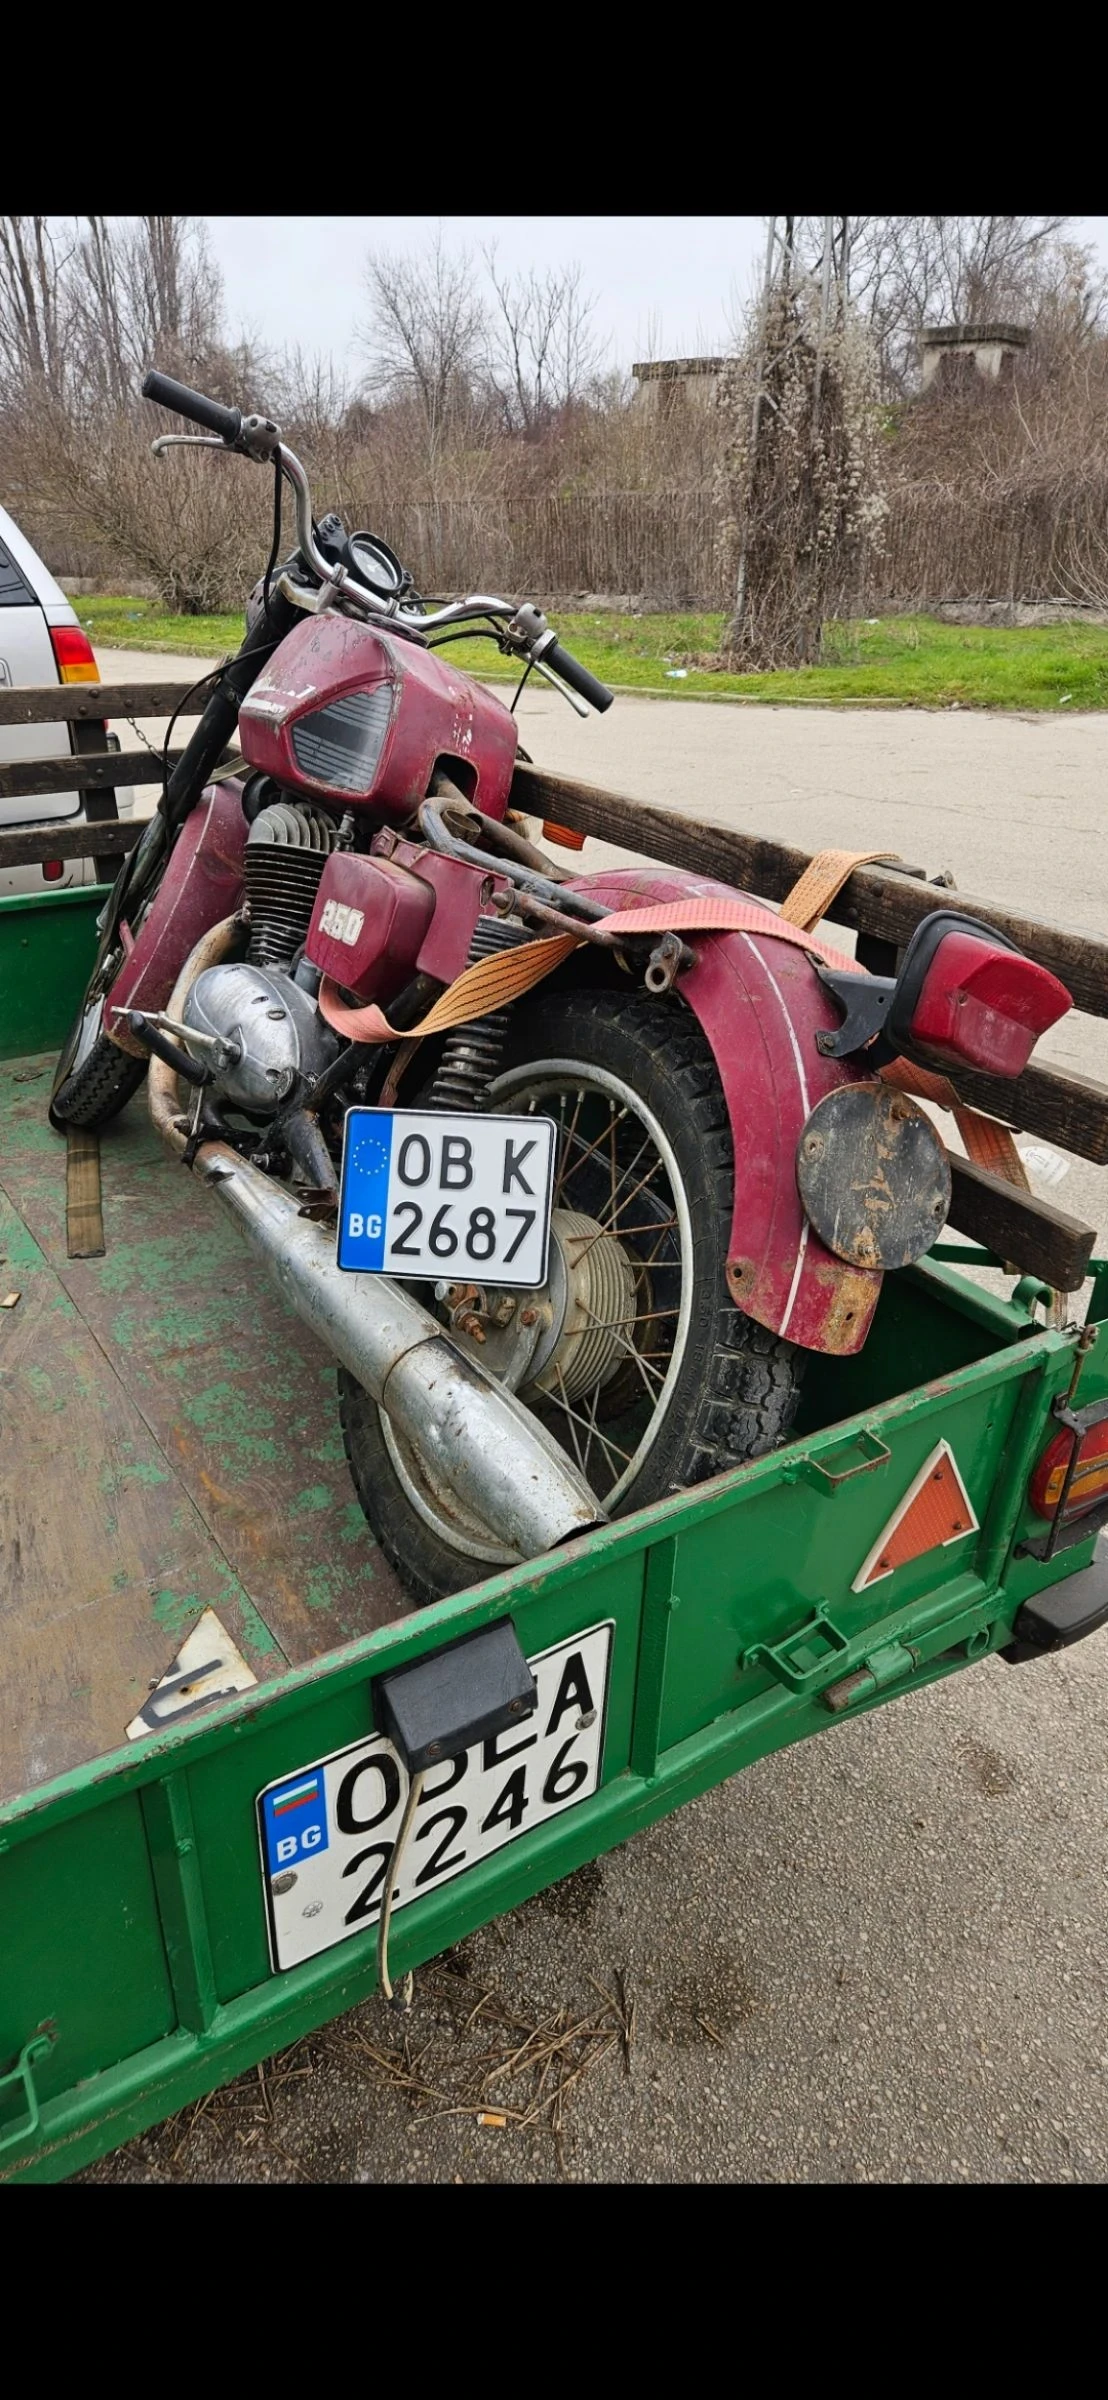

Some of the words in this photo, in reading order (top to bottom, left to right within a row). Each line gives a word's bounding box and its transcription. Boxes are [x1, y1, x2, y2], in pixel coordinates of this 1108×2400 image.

[318, 898, 365, 946] 250
[397, 1133, 474, 1191] OB
[502, 1139, 538, 1196] K
[349, 1213, 382, 1239] BG
[390, 1201, 537, 1264] 2687
[275, 1824, 322, 1863] BG
[341, 1733, 588, 1927] 2246
